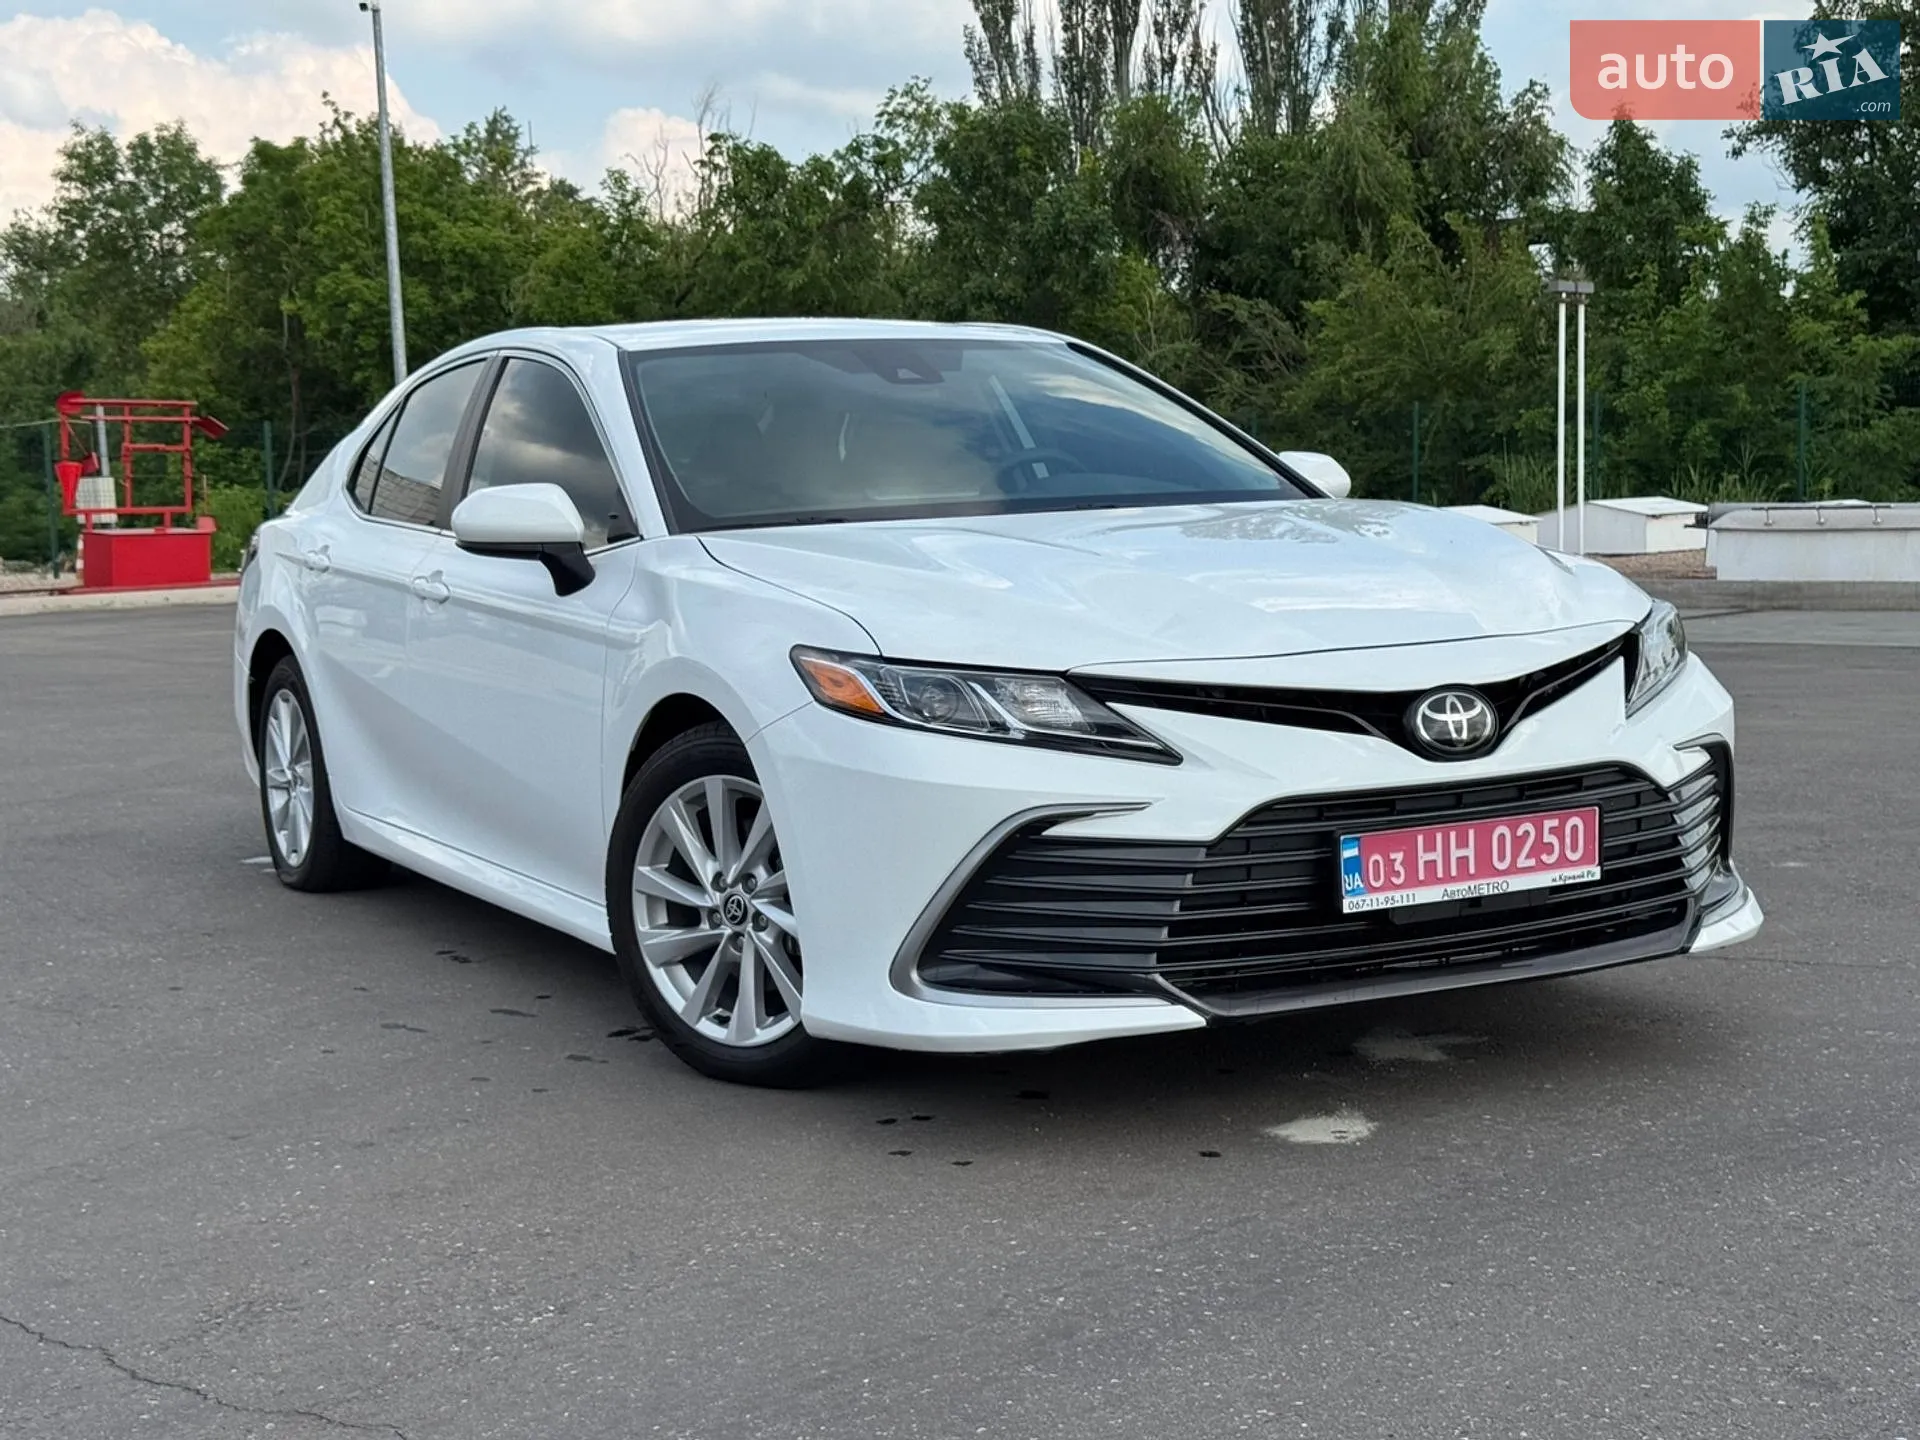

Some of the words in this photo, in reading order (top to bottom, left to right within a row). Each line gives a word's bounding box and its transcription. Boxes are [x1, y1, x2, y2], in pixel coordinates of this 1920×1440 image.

[1368, 851, 1406, 888] 03
[1417, 828, 1476, 881] HH
[1491, 816, 1585, 871] 0250
[1344, 872, 1364, 891] UA
